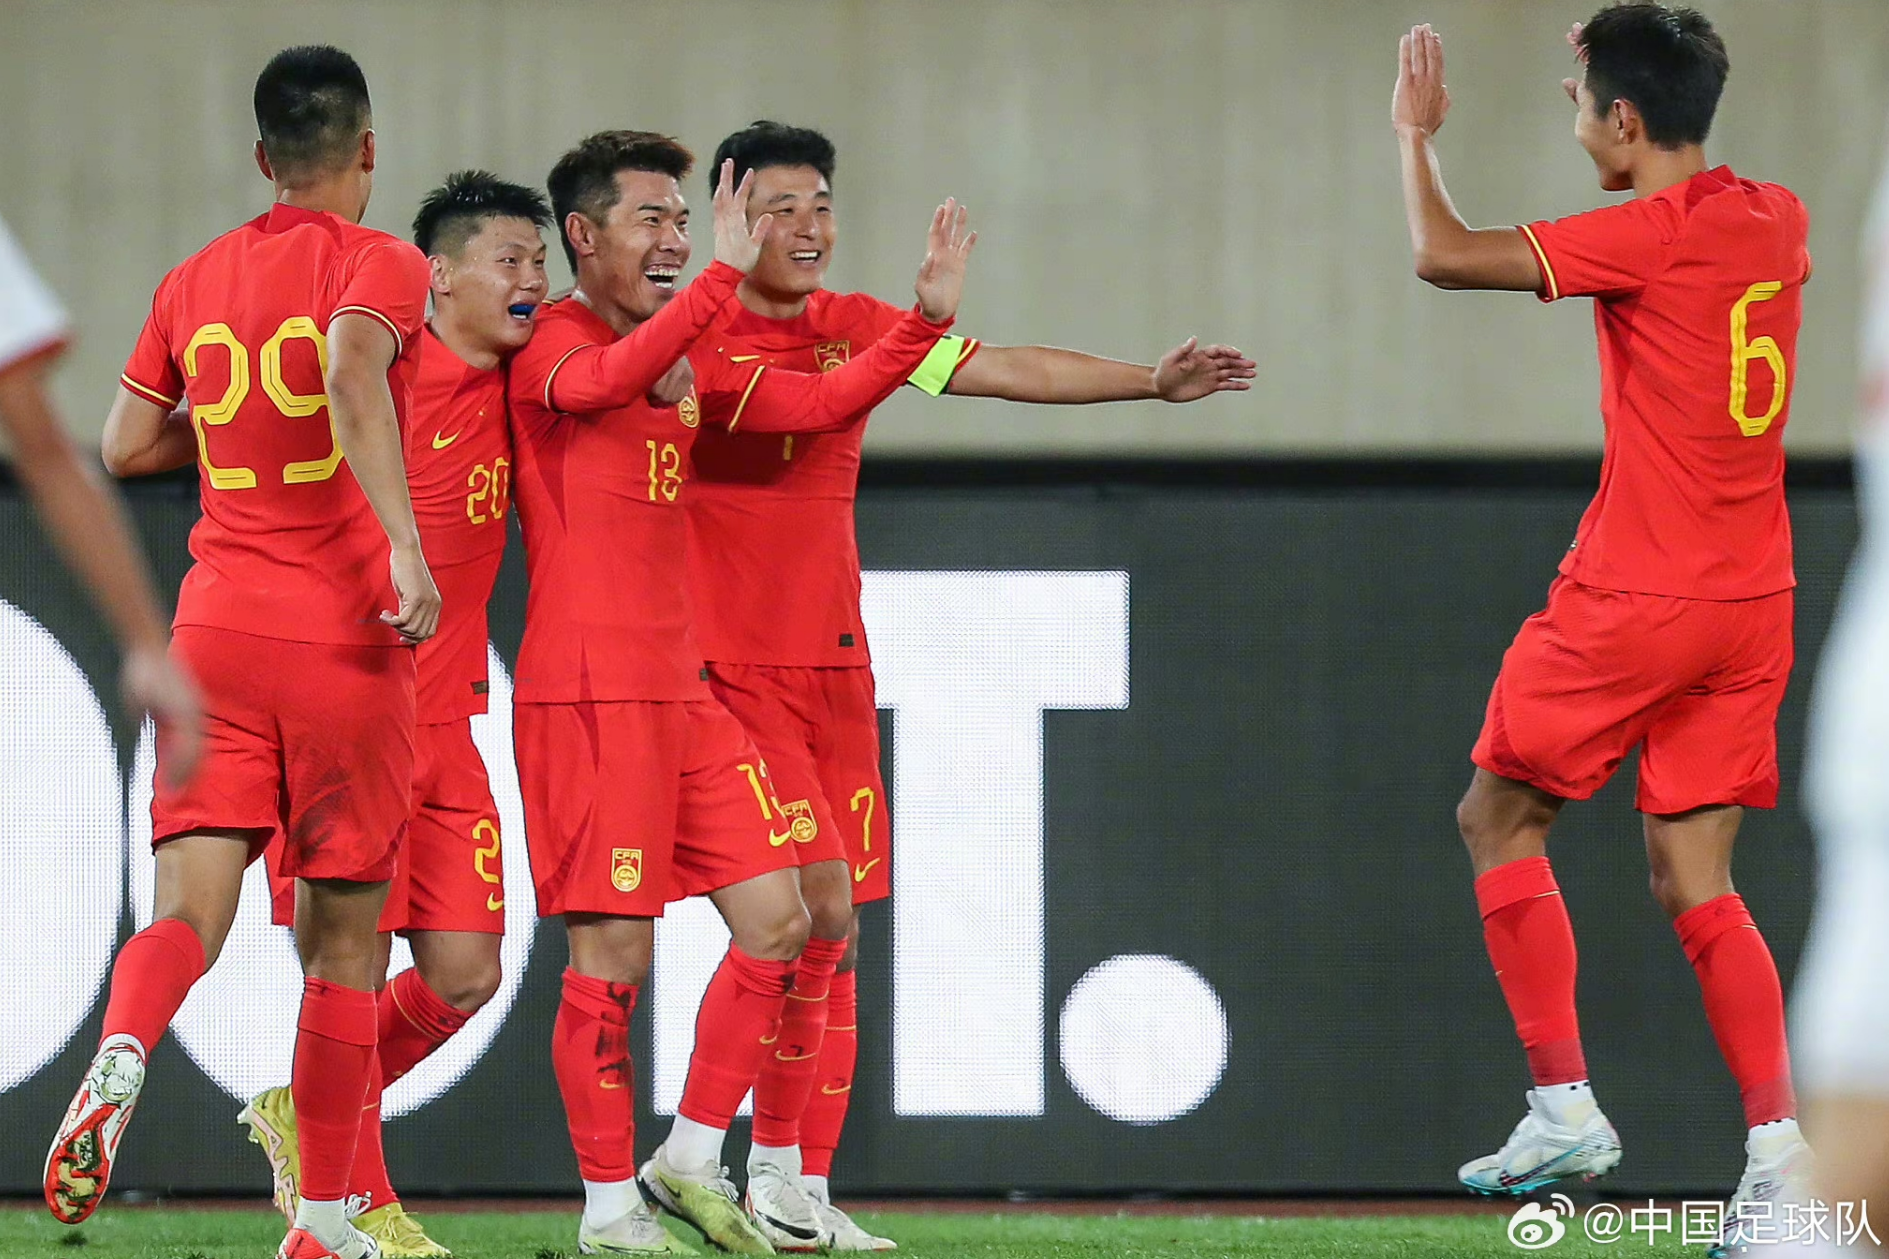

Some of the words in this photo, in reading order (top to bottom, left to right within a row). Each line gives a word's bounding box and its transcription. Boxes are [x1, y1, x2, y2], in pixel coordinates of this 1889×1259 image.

[1728, 280, 1787, 437] 6
[183, 315, 345, 490] 29
[466, 456, 509, 525] 20
[646, 439, 682, 501] 13
[850, 787, 875, 852] 7
[614, 851, 640, 860] CFA
